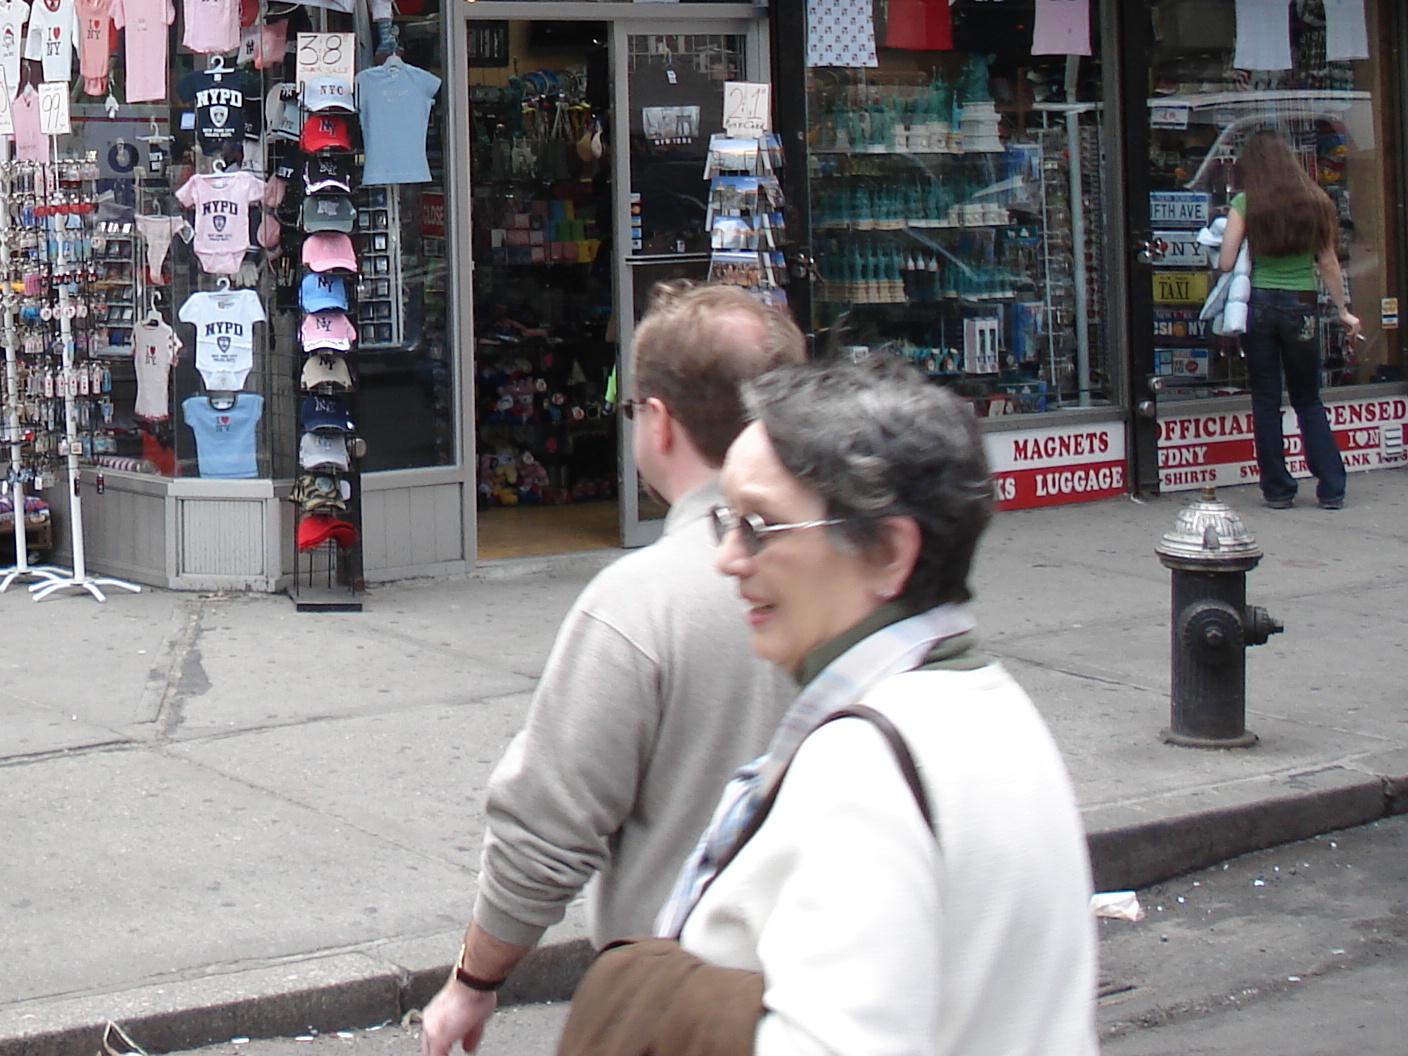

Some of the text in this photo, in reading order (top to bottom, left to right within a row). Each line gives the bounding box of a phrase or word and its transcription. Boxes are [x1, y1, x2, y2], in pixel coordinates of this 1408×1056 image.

[87, 29, 101, 40] NY
[46, 42, 61, 56] NY
[195, 87, 243, 109] NYPD
[320, 85, 344, 95] NYC
[319, 119, 338, 138] NY
[202, 200, 238, 216] NYPD
[1180, 204, 1205, 219] AVE.
[318, 277, 334, 292] NY
[1159, 281, 1190, 300] TAXI
[204, 321, 243, 337] NYPD
[316, 317, 332, 332] NY
[319, 356, 336, 370] NY
[1013, 431, 1109, 462] MAGNETS
[1159, 446, 1207, 467] FDNY
[1035, 465, 1124, 497] LUGGAGE
